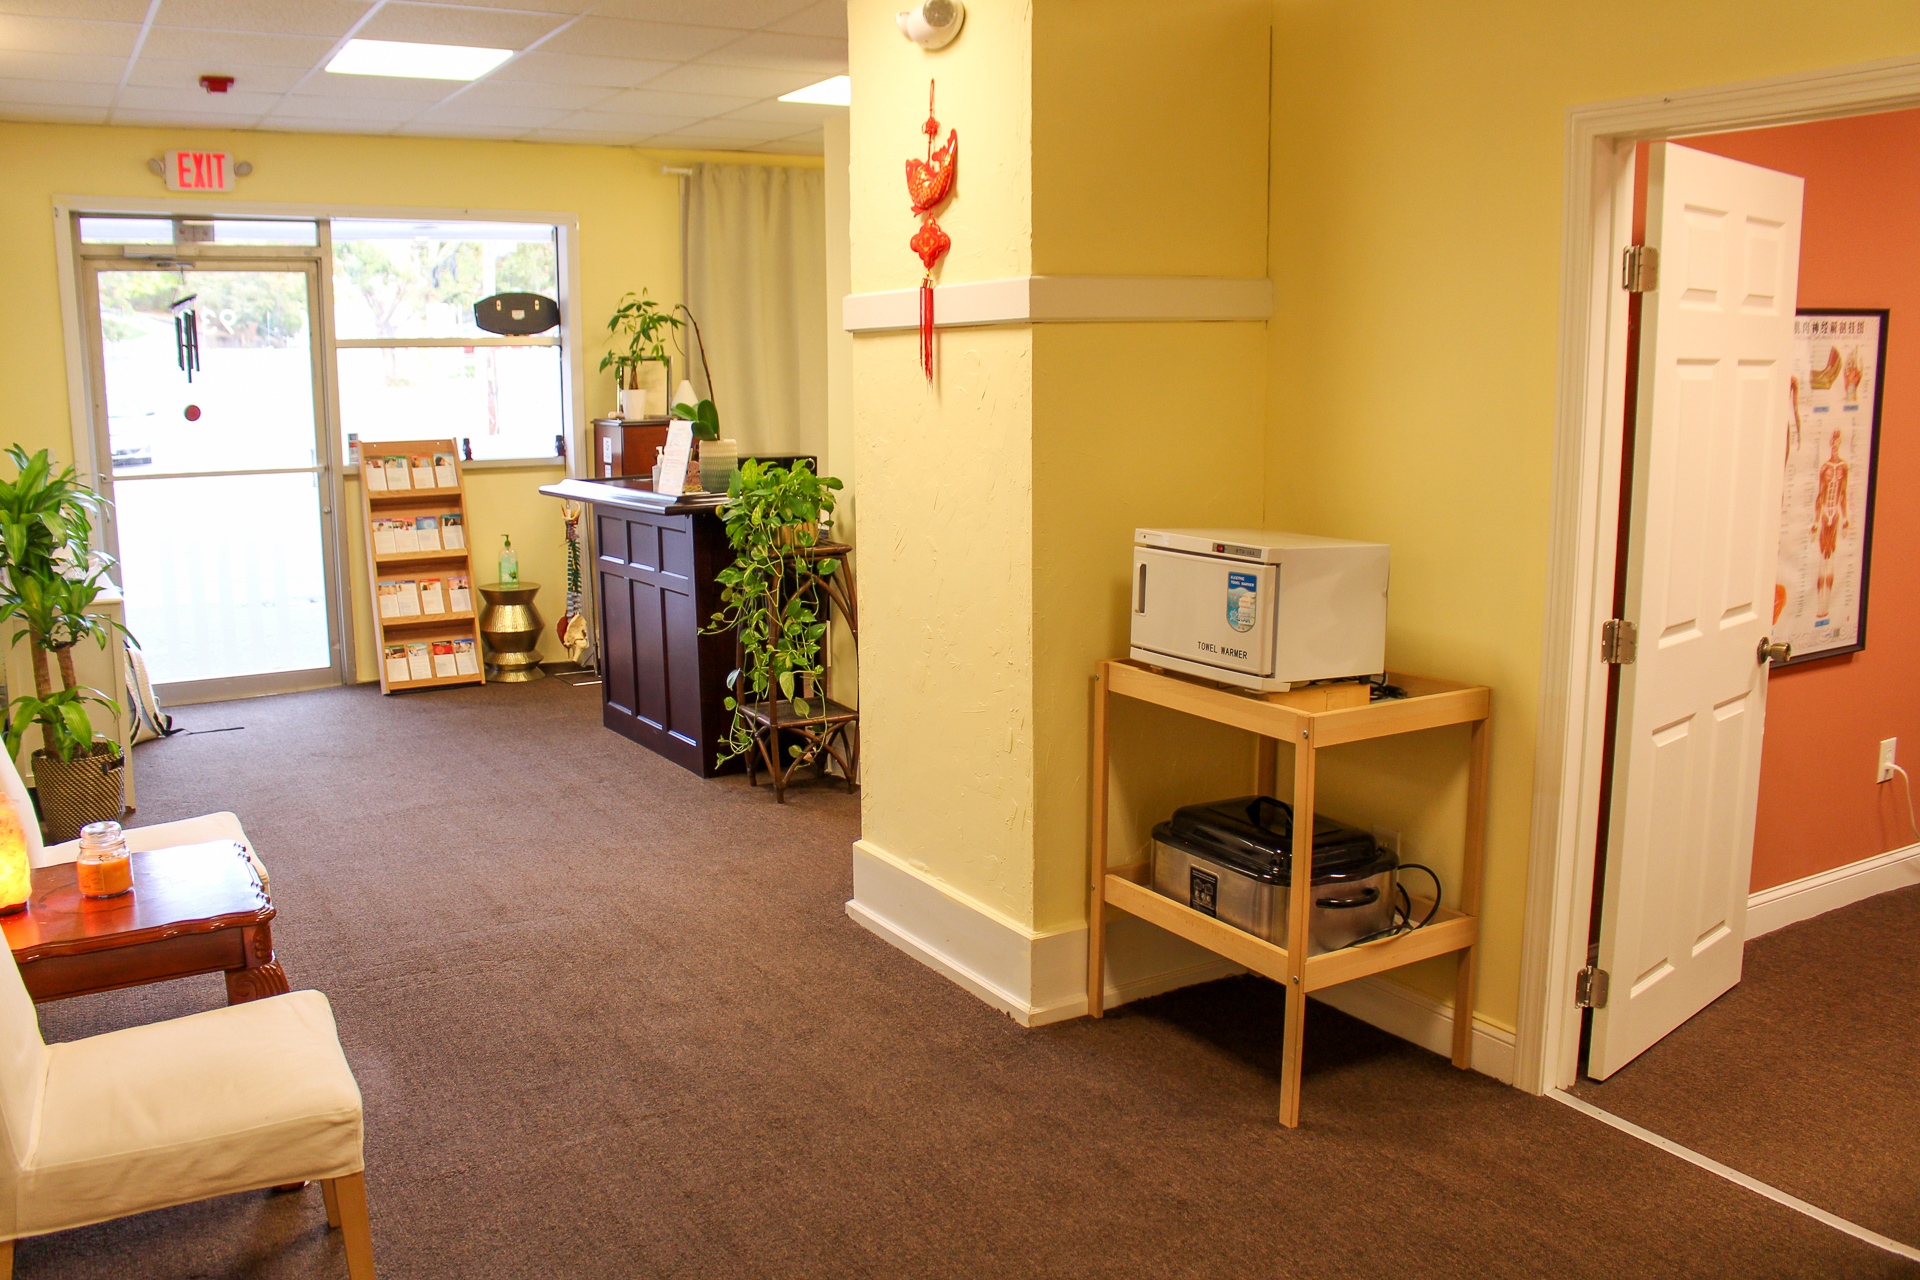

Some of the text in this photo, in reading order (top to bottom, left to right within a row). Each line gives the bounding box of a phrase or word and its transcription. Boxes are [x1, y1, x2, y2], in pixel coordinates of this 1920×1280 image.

[176, 151, 225, 190] EXIT
[1197, 641, 1248, 660] TOWEL WARMER
